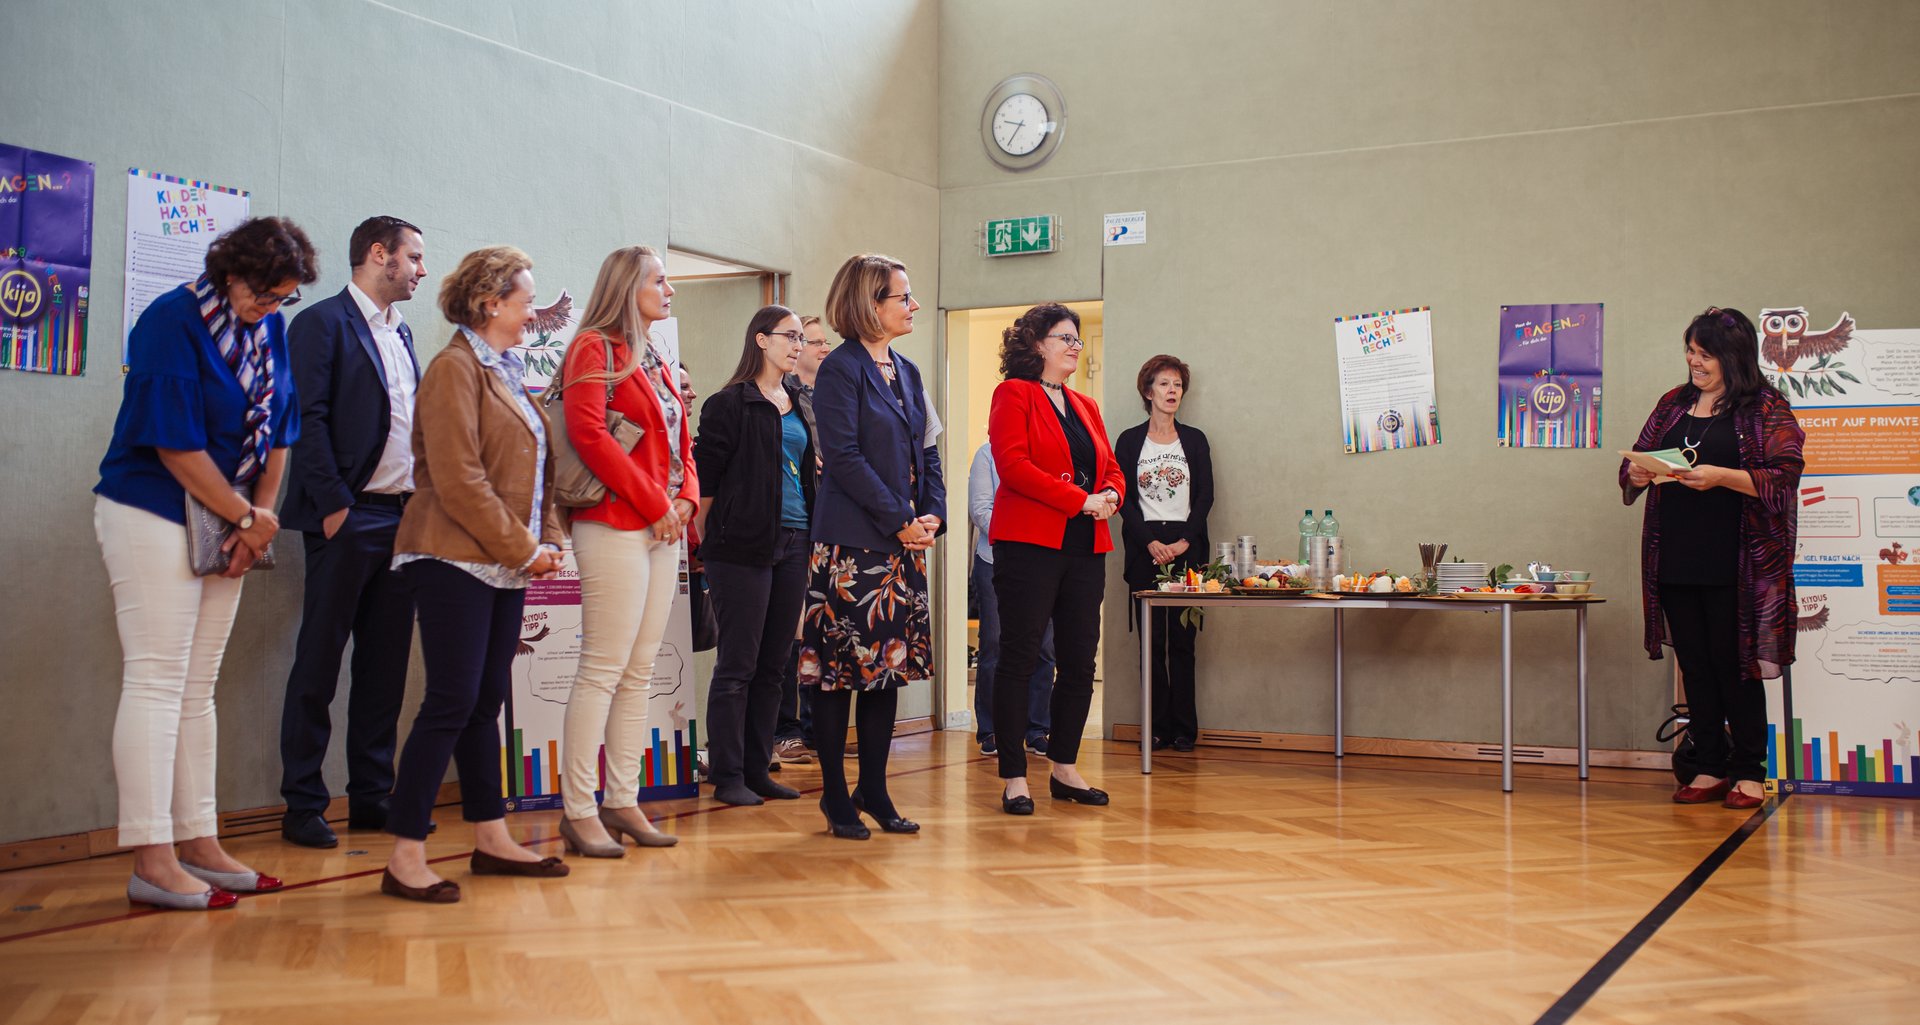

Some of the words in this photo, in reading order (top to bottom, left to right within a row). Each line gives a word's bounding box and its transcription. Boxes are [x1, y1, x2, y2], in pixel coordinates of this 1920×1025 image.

[157, 188, 207, 204] KINDER
[160, 203, 207, 220] HABEN
[3, 280, 36, 316] kija
[1357, 315, 1395, 335] KINDER
[1360, 325, 1395, 345] HABEN
[1538, 391, 1561, 413] kija
[1799, 417, 1838, 428] RECHT
[1842, 417, 1866, 427] AUF
[1870, 416, 1919, 427] PRIVATE
[1801, 594, 1828, 604] KIYOUS
[1803, 603, 1819, 612] TIPP
[522, 611, 548, 624] KIYOUS
[524, 622, 540, 632] TIPP
